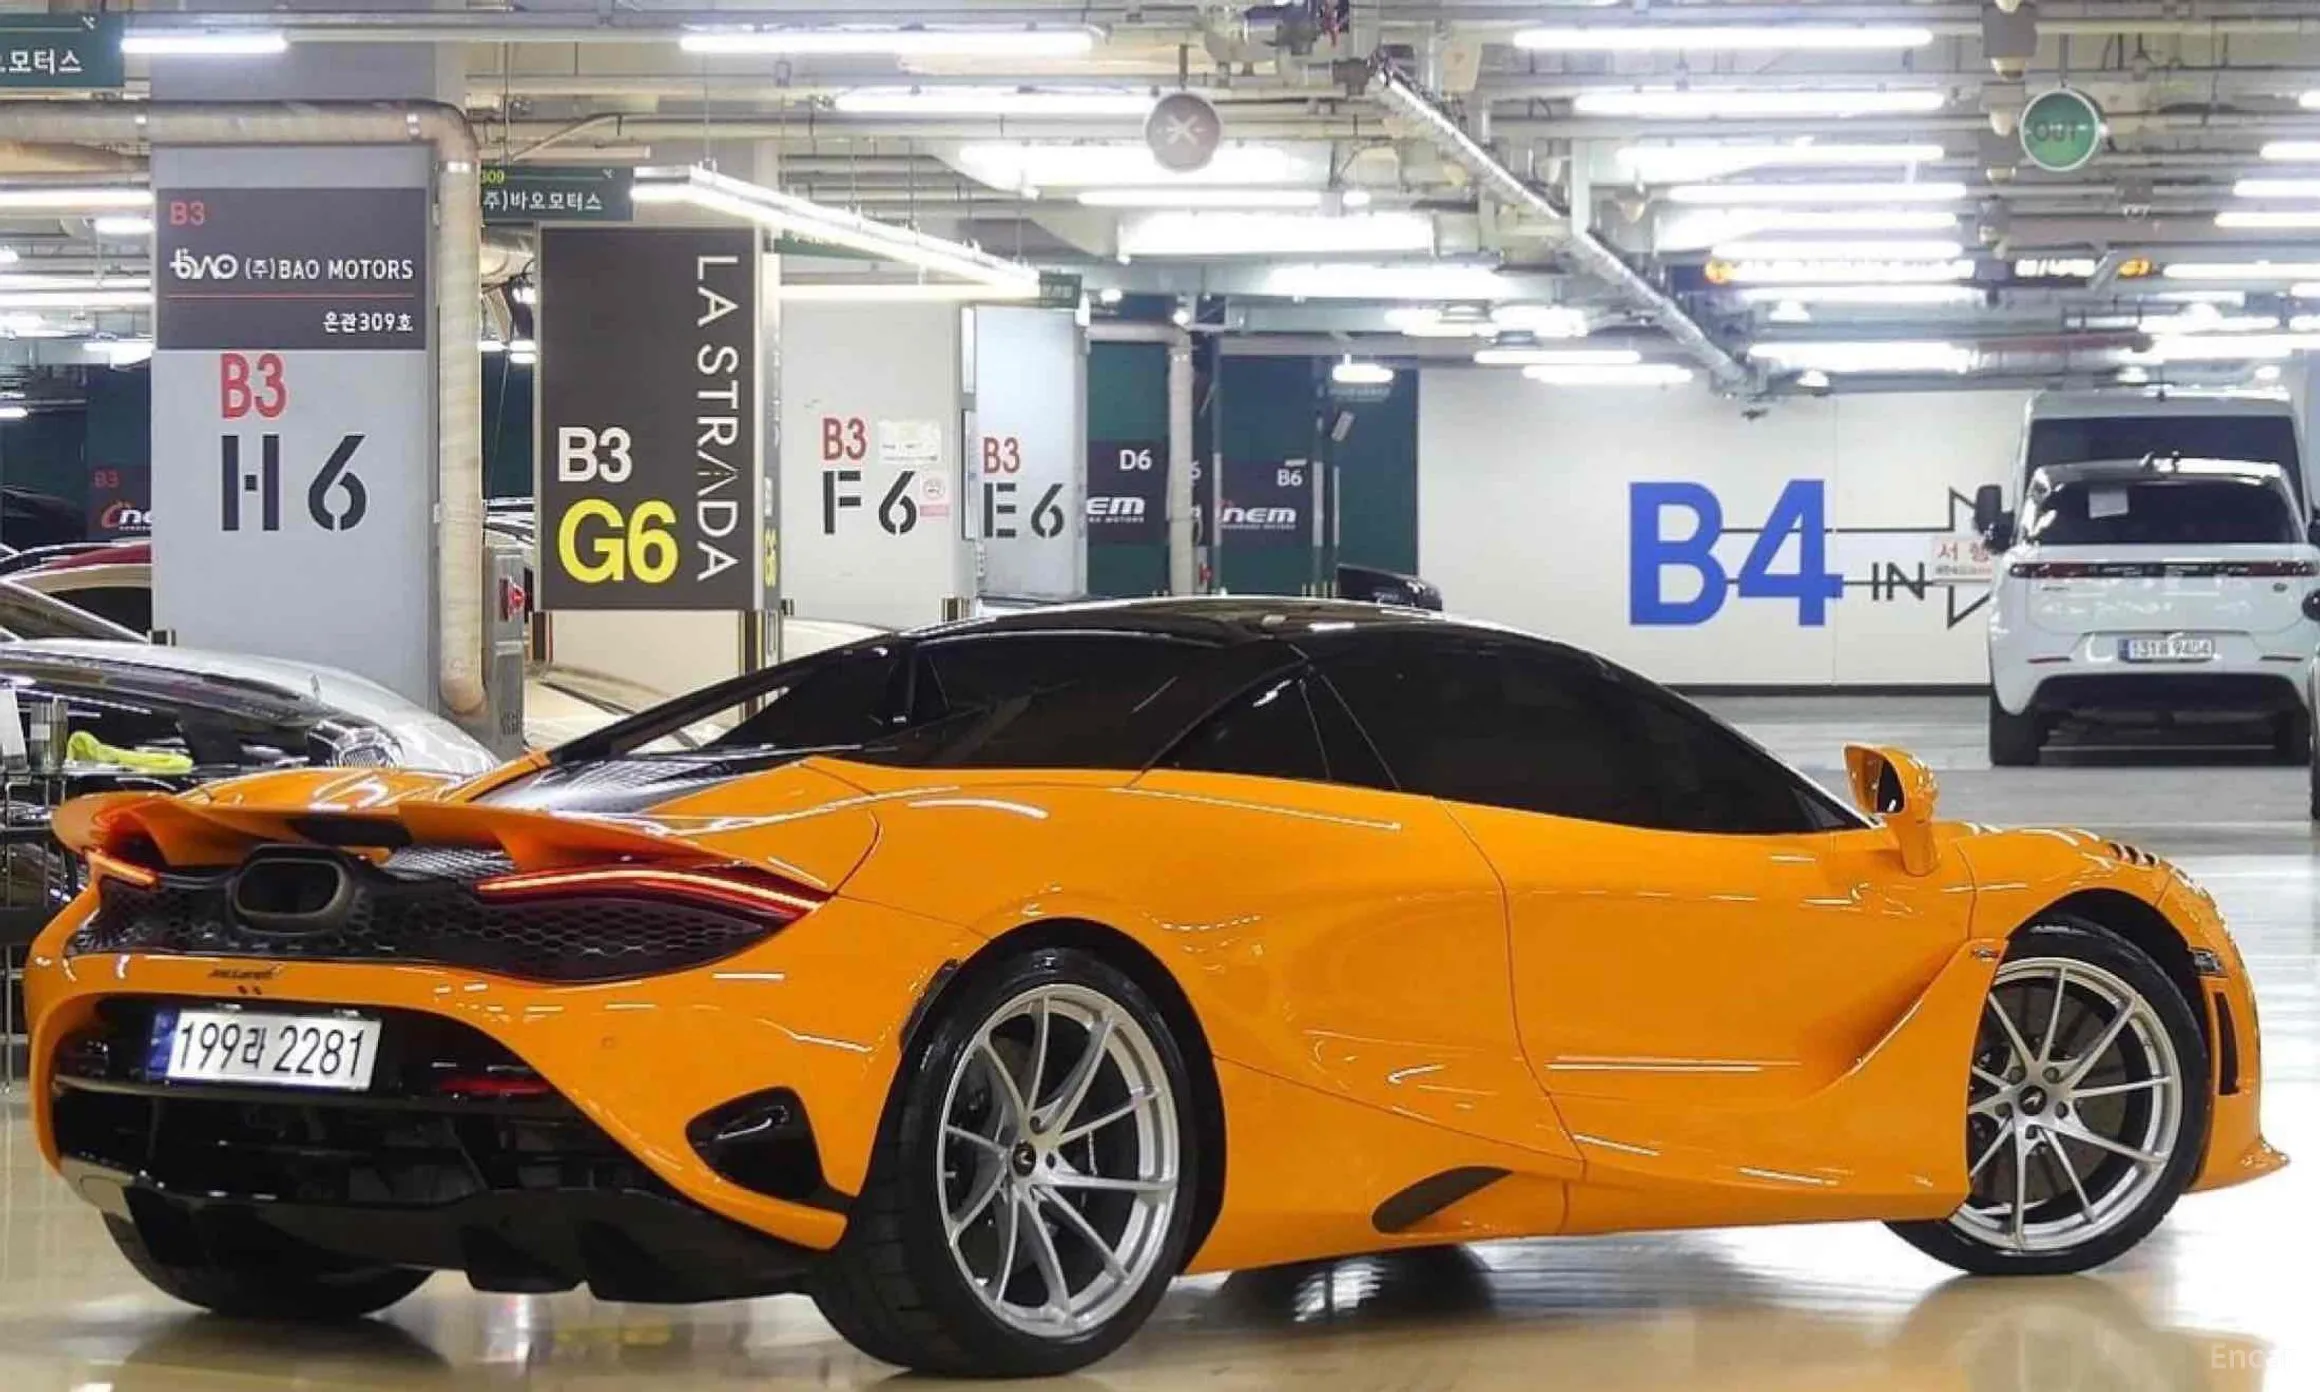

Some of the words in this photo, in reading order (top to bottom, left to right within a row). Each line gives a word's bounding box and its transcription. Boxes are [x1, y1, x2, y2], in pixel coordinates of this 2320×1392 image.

[169, 201, 206, 226] B3
[327, 258, 414, 280] MOTORS
[697, 255, 739, 327] LA
[221, 353, 287, 418] B3
[558, 426, 633, 482] B3
[697, 343, 740, 582] STRADA
[822, 417, 866, 460] B3
[982, 436, 1020, 474] B3
[1119, 449, 1152, 471] D6
[1276, 468, 1303, 487] B6
[558, 498, 679, 584] G6
[1629, 479, 1844, 626] B4
[1871, 562, 1925, 600] IN
[180, 1020, 267, 1070] 199라
[273, 1025, 364, 1078] 2281
